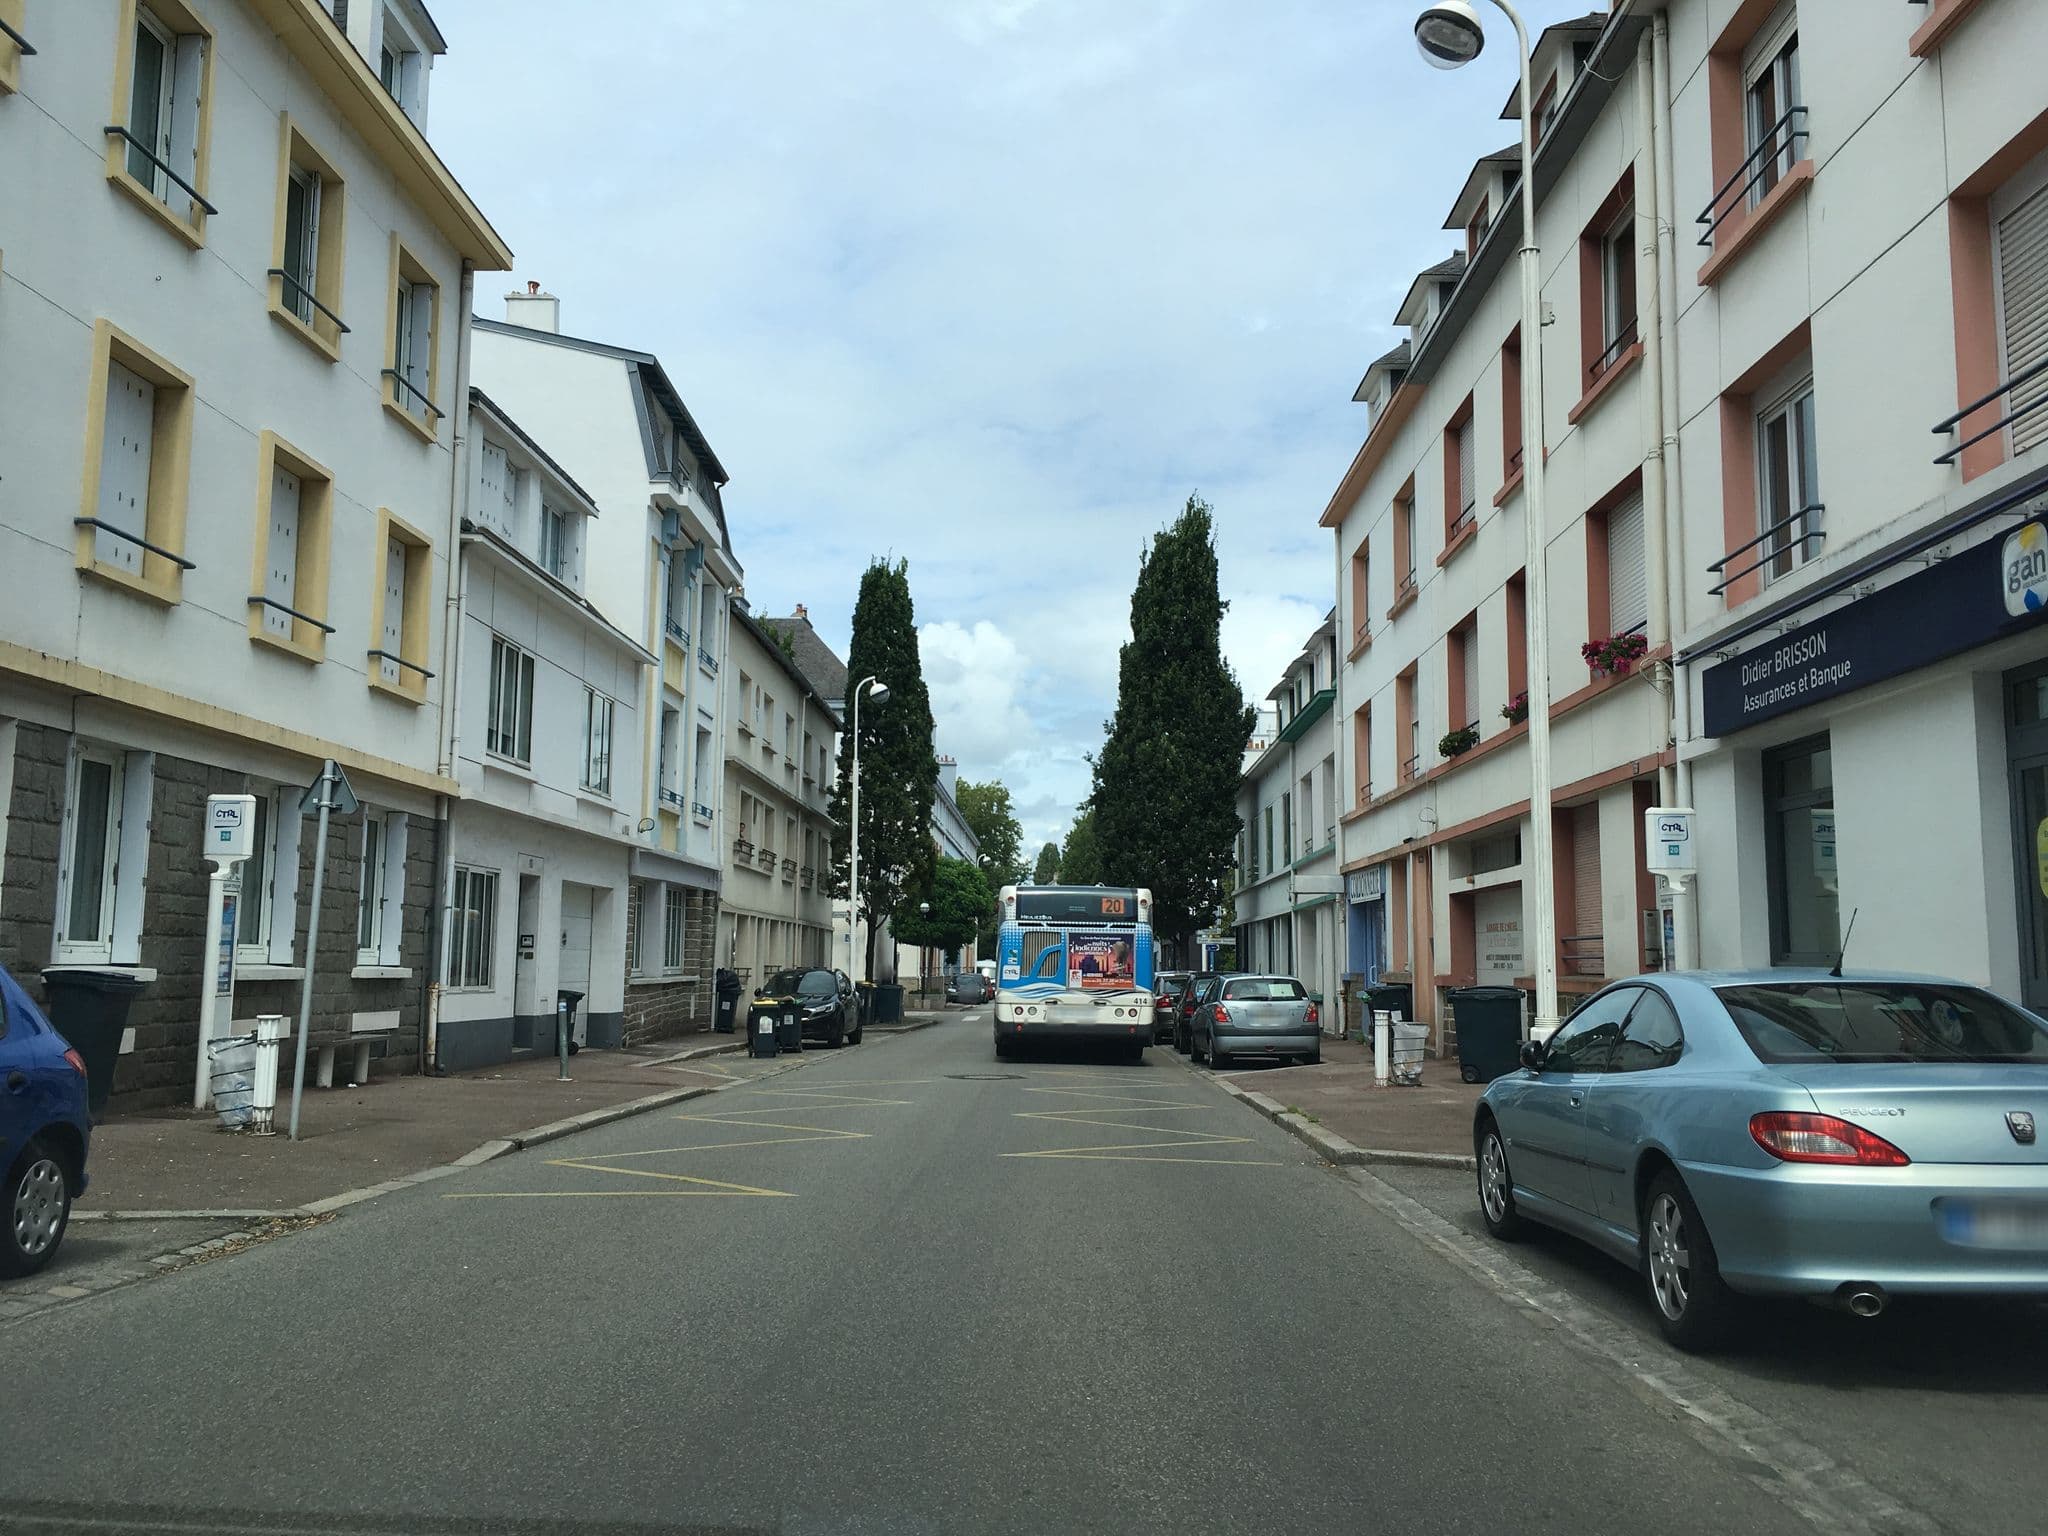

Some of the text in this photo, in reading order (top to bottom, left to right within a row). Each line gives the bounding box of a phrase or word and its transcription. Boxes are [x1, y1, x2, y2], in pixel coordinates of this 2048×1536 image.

[2009, 549, 2047, 594] gan
[1742, 630, 1827, 687] Didier BRISSON
[1743, 659, 1851, 713] Assurances et Banque
[1105, 900, 1121, 912] 20
[1133, 997, 1148, 1005] 414
[1839, 1107, 1907, 1117] PEUGEOT
